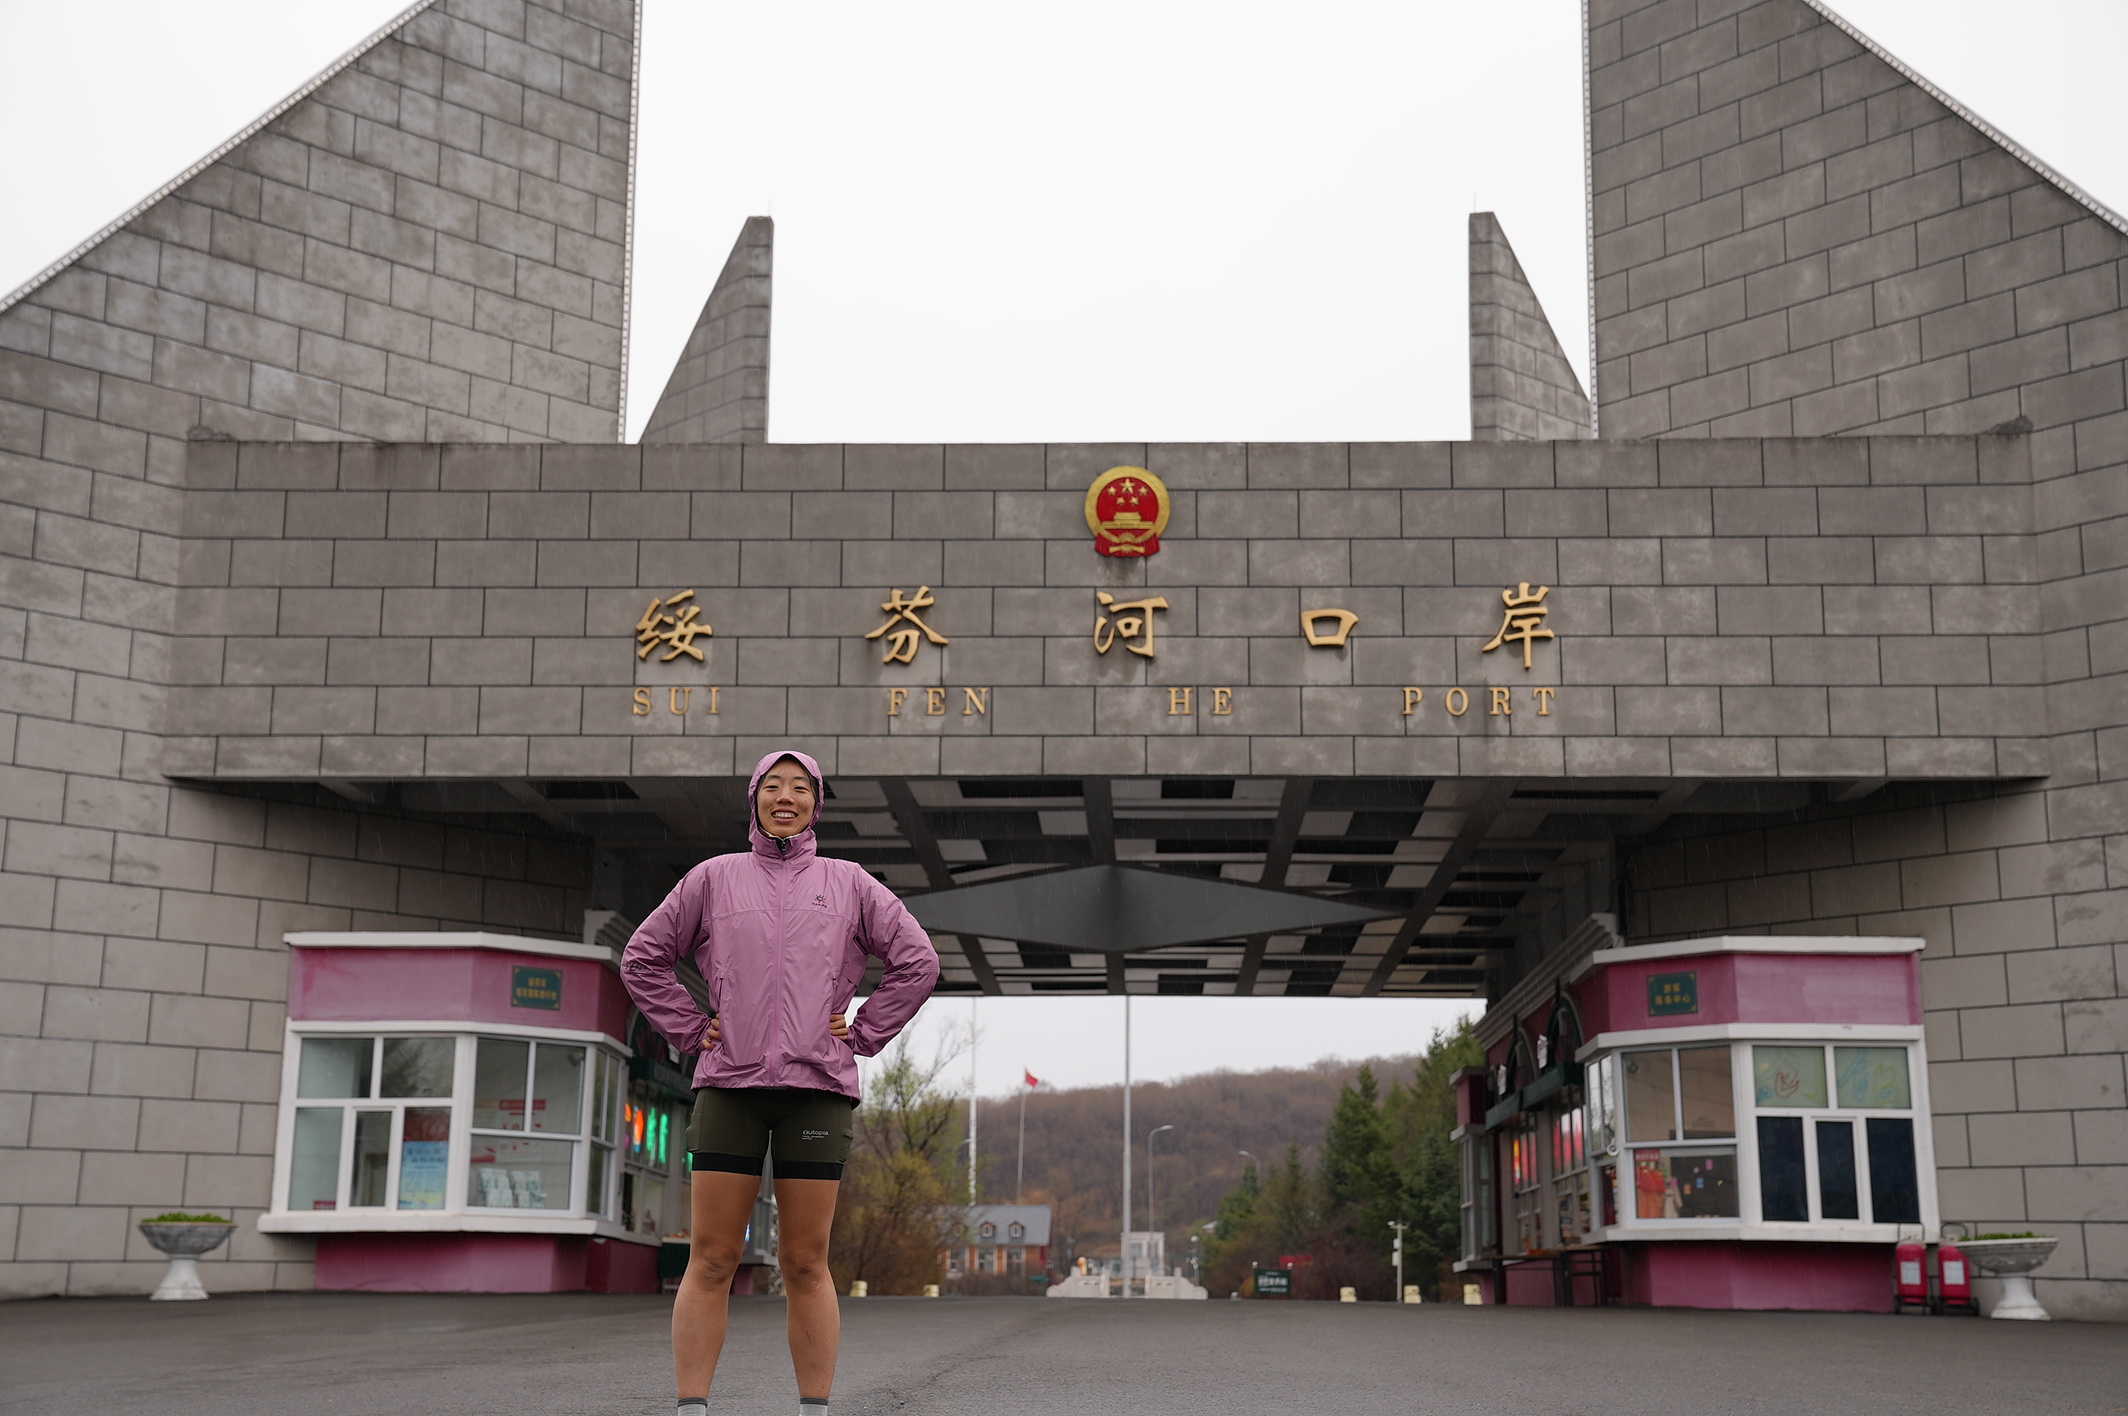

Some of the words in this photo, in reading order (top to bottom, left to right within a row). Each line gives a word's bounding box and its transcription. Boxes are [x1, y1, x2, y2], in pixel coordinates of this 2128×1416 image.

[635, 582, 1556, 670] 绥芬河口岸
[632, 687, 721, 716] SUI
[888, 687, 990, 716] FEN
[1168, 687, 1233, 716] HE
[1402, 686, 1556, 716] PORT
